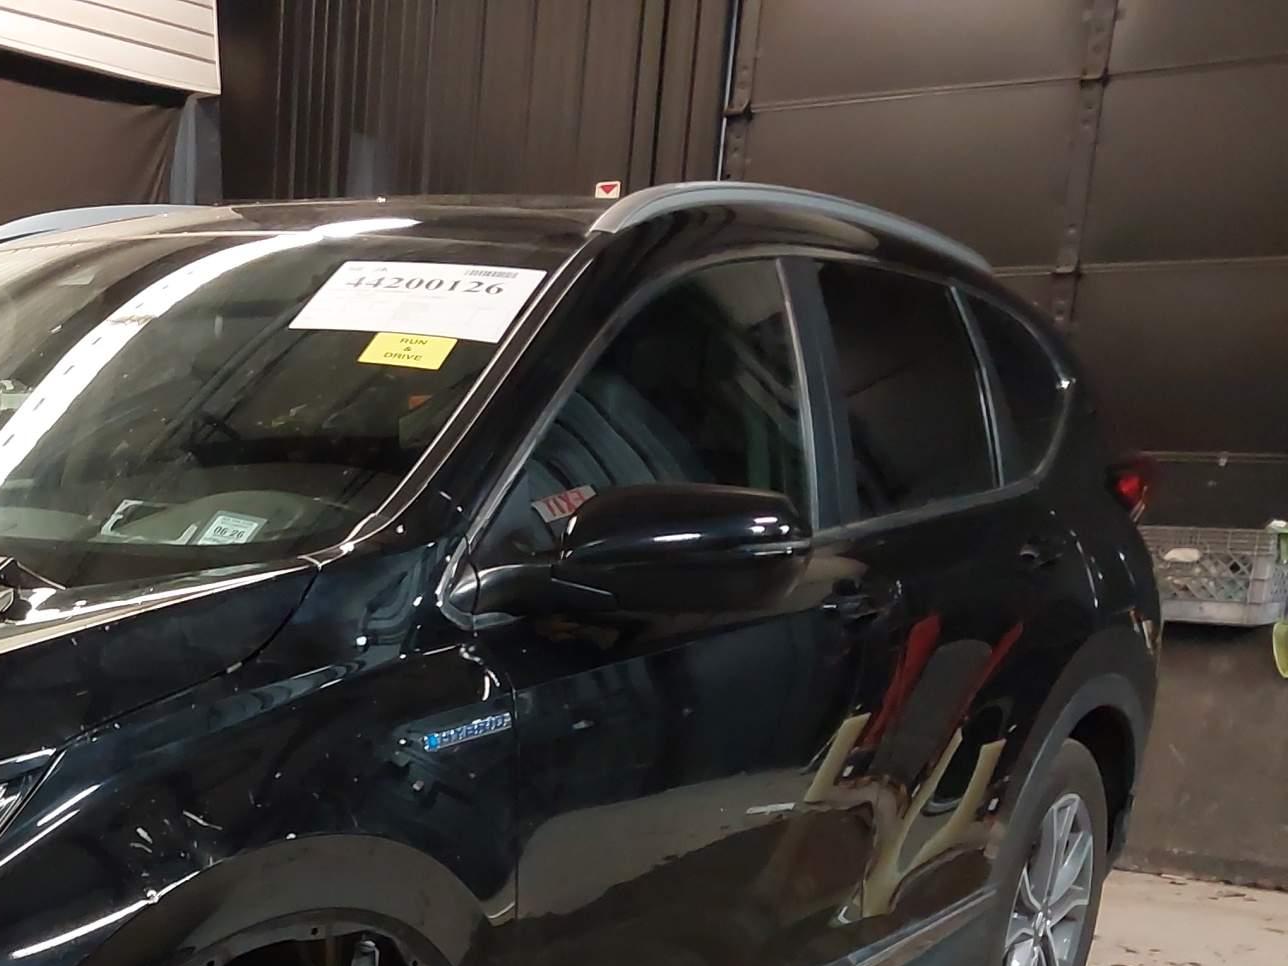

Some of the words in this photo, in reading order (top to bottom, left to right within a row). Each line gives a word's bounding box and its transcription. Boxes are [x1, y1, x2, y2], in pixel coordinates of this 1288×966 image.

[346, 276, 506, 296] 44200126
[399, 337, 429, 346] RUN
[383, 351, 423, 361] DRIVE
